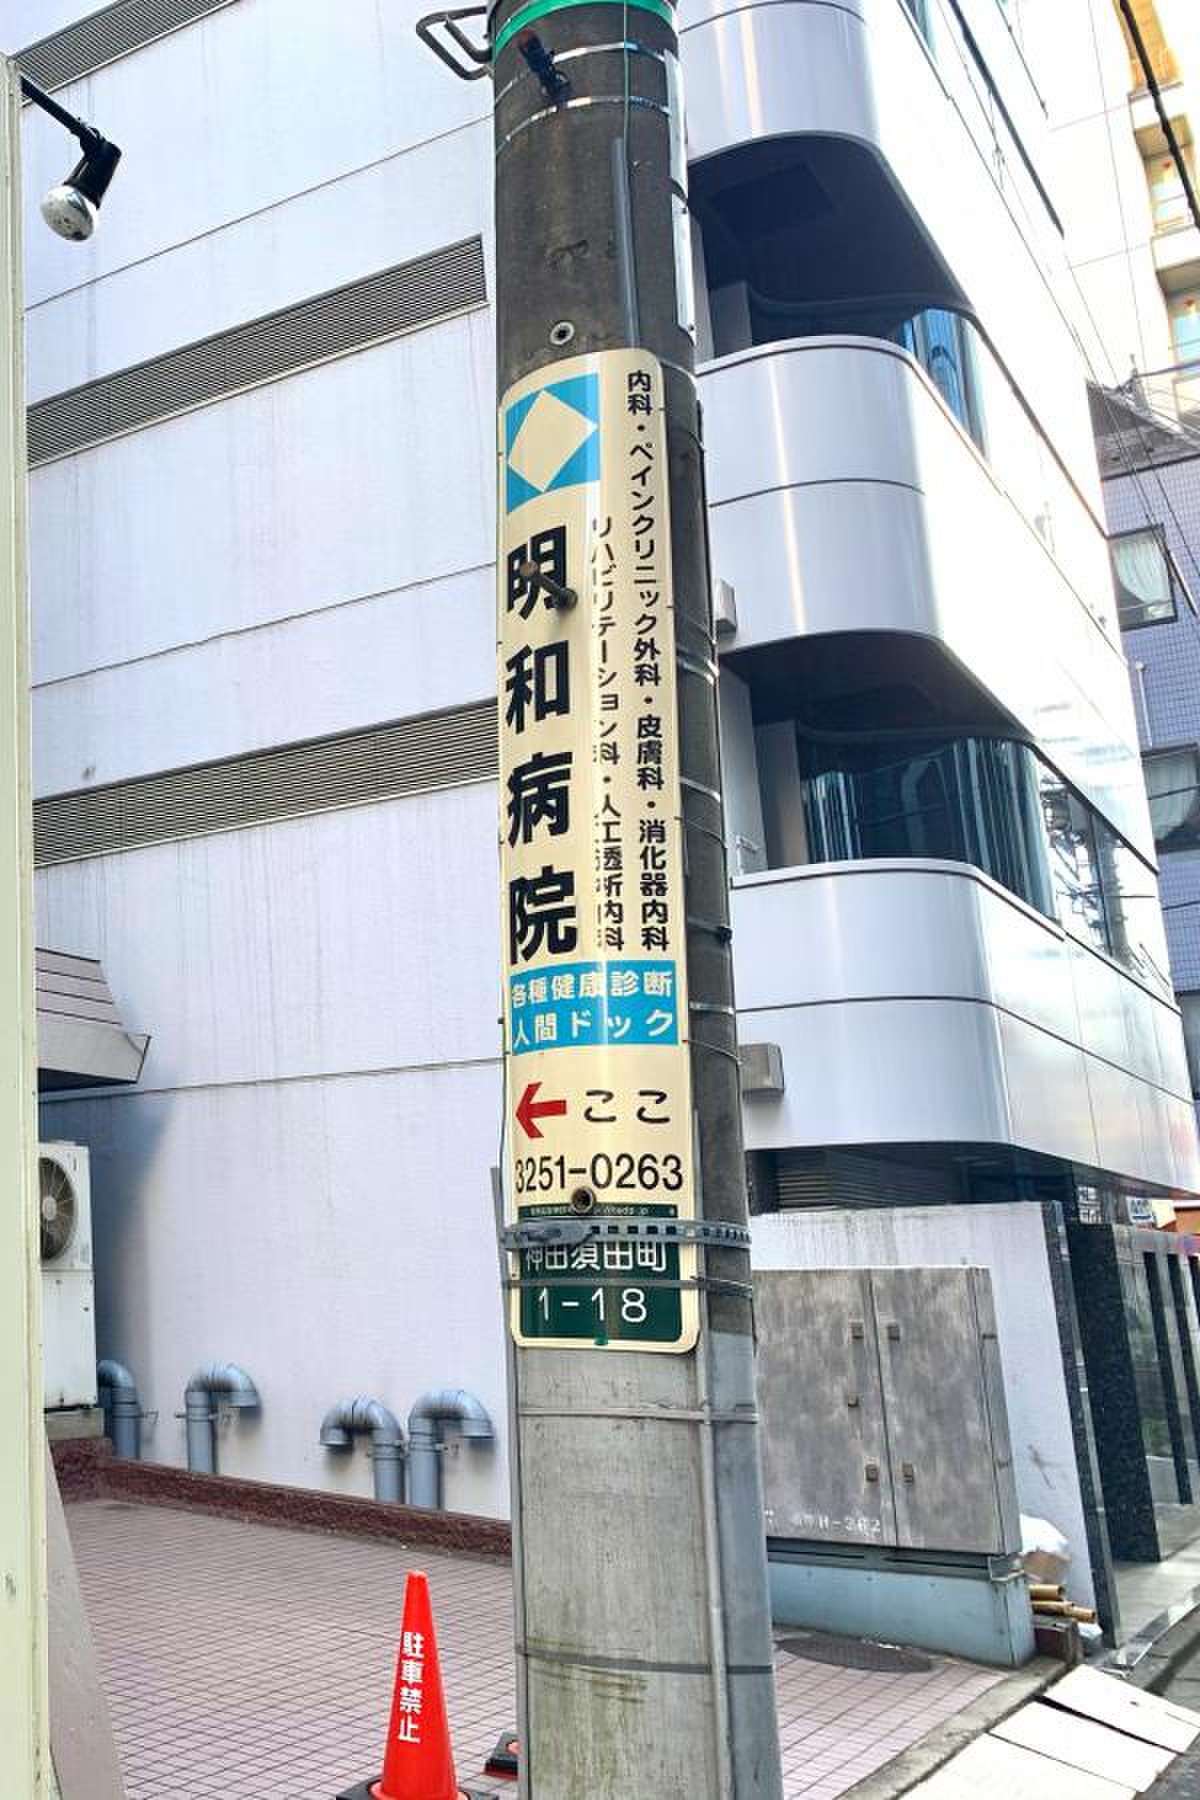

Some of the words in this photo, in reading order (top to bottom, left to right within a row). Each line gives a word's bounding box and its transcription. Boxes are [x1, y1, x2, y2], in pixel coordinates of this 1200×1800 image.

[505, 525, 578, 966] 明和病院
[511, 970, 674, 1009] 各種健康診断
[513, 1009, 674, 1050] 人間ドック
[583, 1089, 671, 1124] ここ
[514, 1152, 684, 1194] 3251-0263
[537, 1286, 648, 1323] 1-18
[398, 1630, 425, 1744] 駐車禁止
